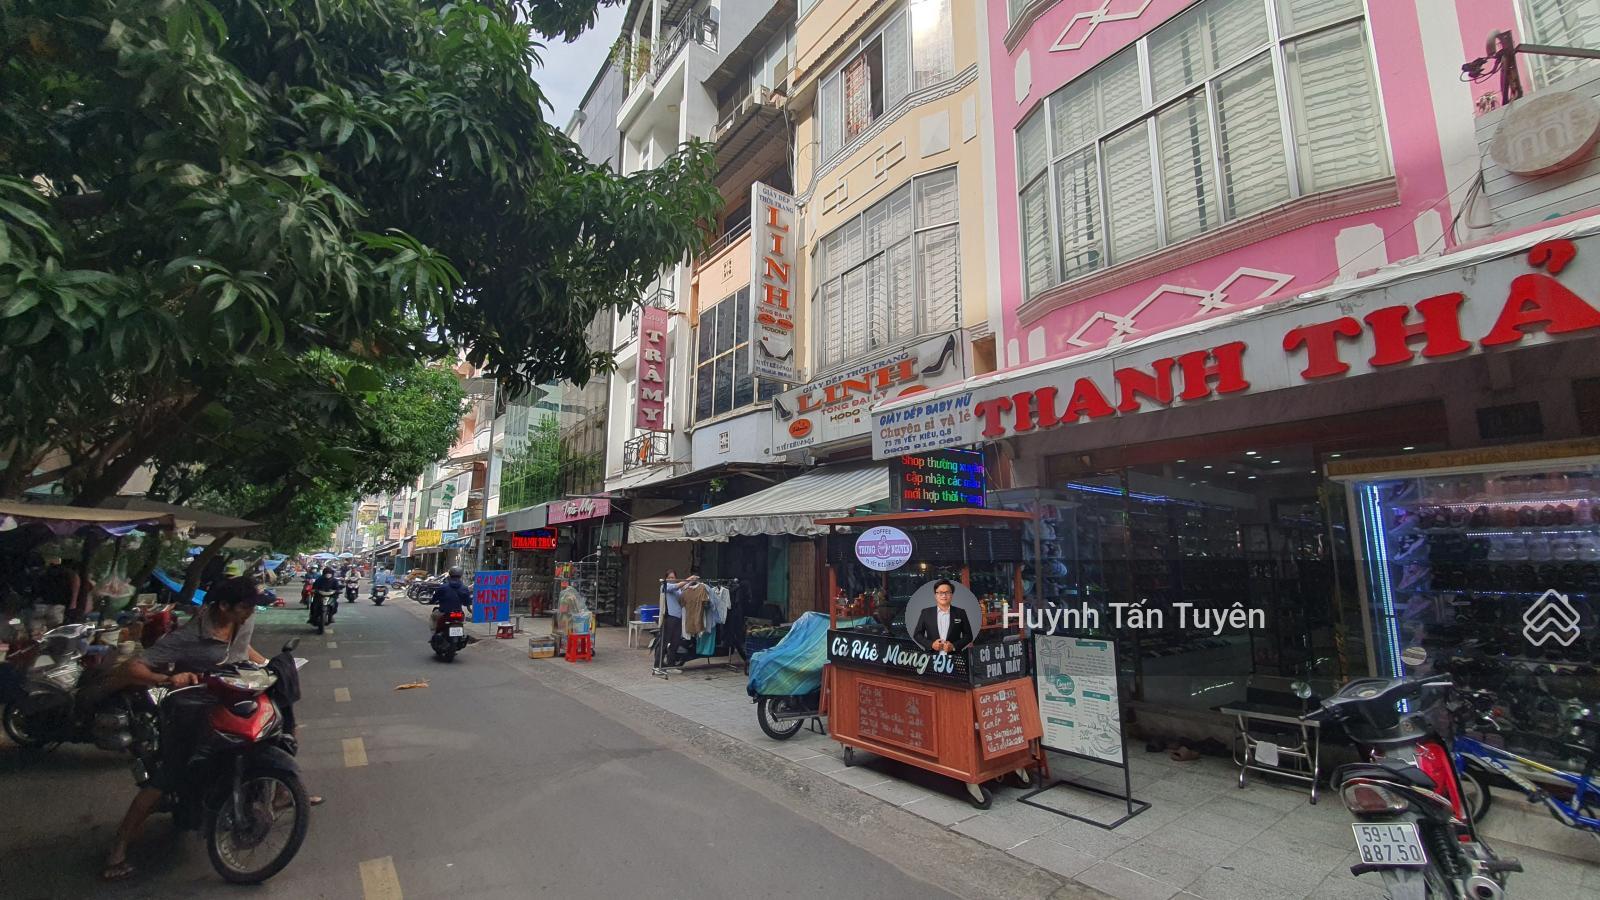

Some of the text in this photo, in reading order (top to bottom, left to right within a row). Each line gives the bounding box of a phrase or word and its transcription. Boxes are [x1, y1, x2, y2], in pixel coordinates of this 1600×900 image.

[762, 205, 791, 312] LINH
[871, 352, 909, 369] TRANG
[797, 356, 918, 415] LINH
[975, 340, 1251, 438] THANH
[904, 405, 923, 421] DÉP
[925, 398, 953, 416] BABY
[880, 422, 921, 440] Chuyên
[902, 455, 925, 469] Shop
[906, 471, 923, 485] cập
[925, 473, 945, 487] nhật
[947, 475, 962, 486] các
[922, 488, 940, 503] hợp
[872, 528, 892, 536] COFFEE
[477, 589, 508, 604] MINH
[831, 636, 954, 674] Cà Phê Mang Đi
[980, 640, 1023, 663] CÓ CÀ PHÊ
[986, 657, 1021, 678] PHA MÁY
[1361, 826, 1407, 843] 59-L1
[1362, 844, 1420, 862] 887.50
